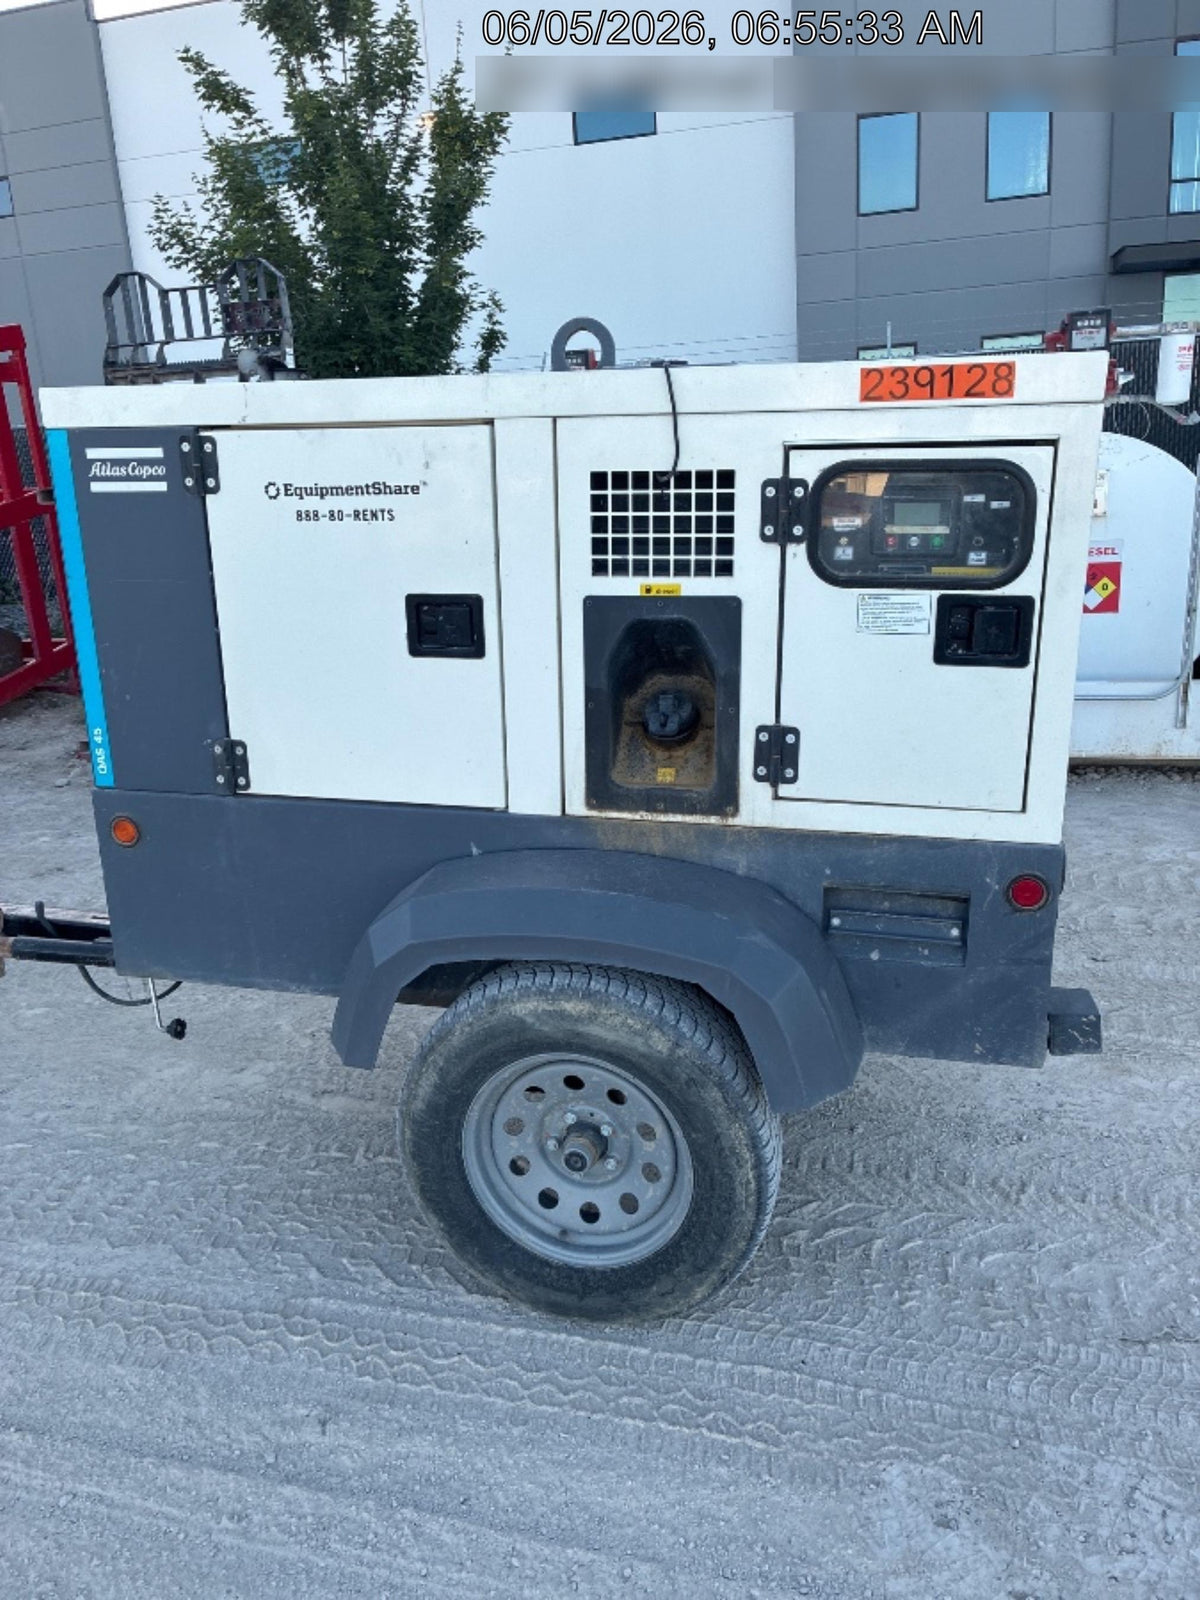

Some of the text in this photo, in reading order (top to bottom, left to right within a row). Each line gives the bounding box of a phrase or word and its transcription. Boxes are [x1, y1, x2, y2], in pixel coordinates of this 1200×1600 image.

[863, 362, 1014, 401] 239128
[283, 481, 421, 500] EquipmentShare
[295, 508, 396, 522] 888-80-RENTS
[1088, 547, 1119, 556] ESEL
